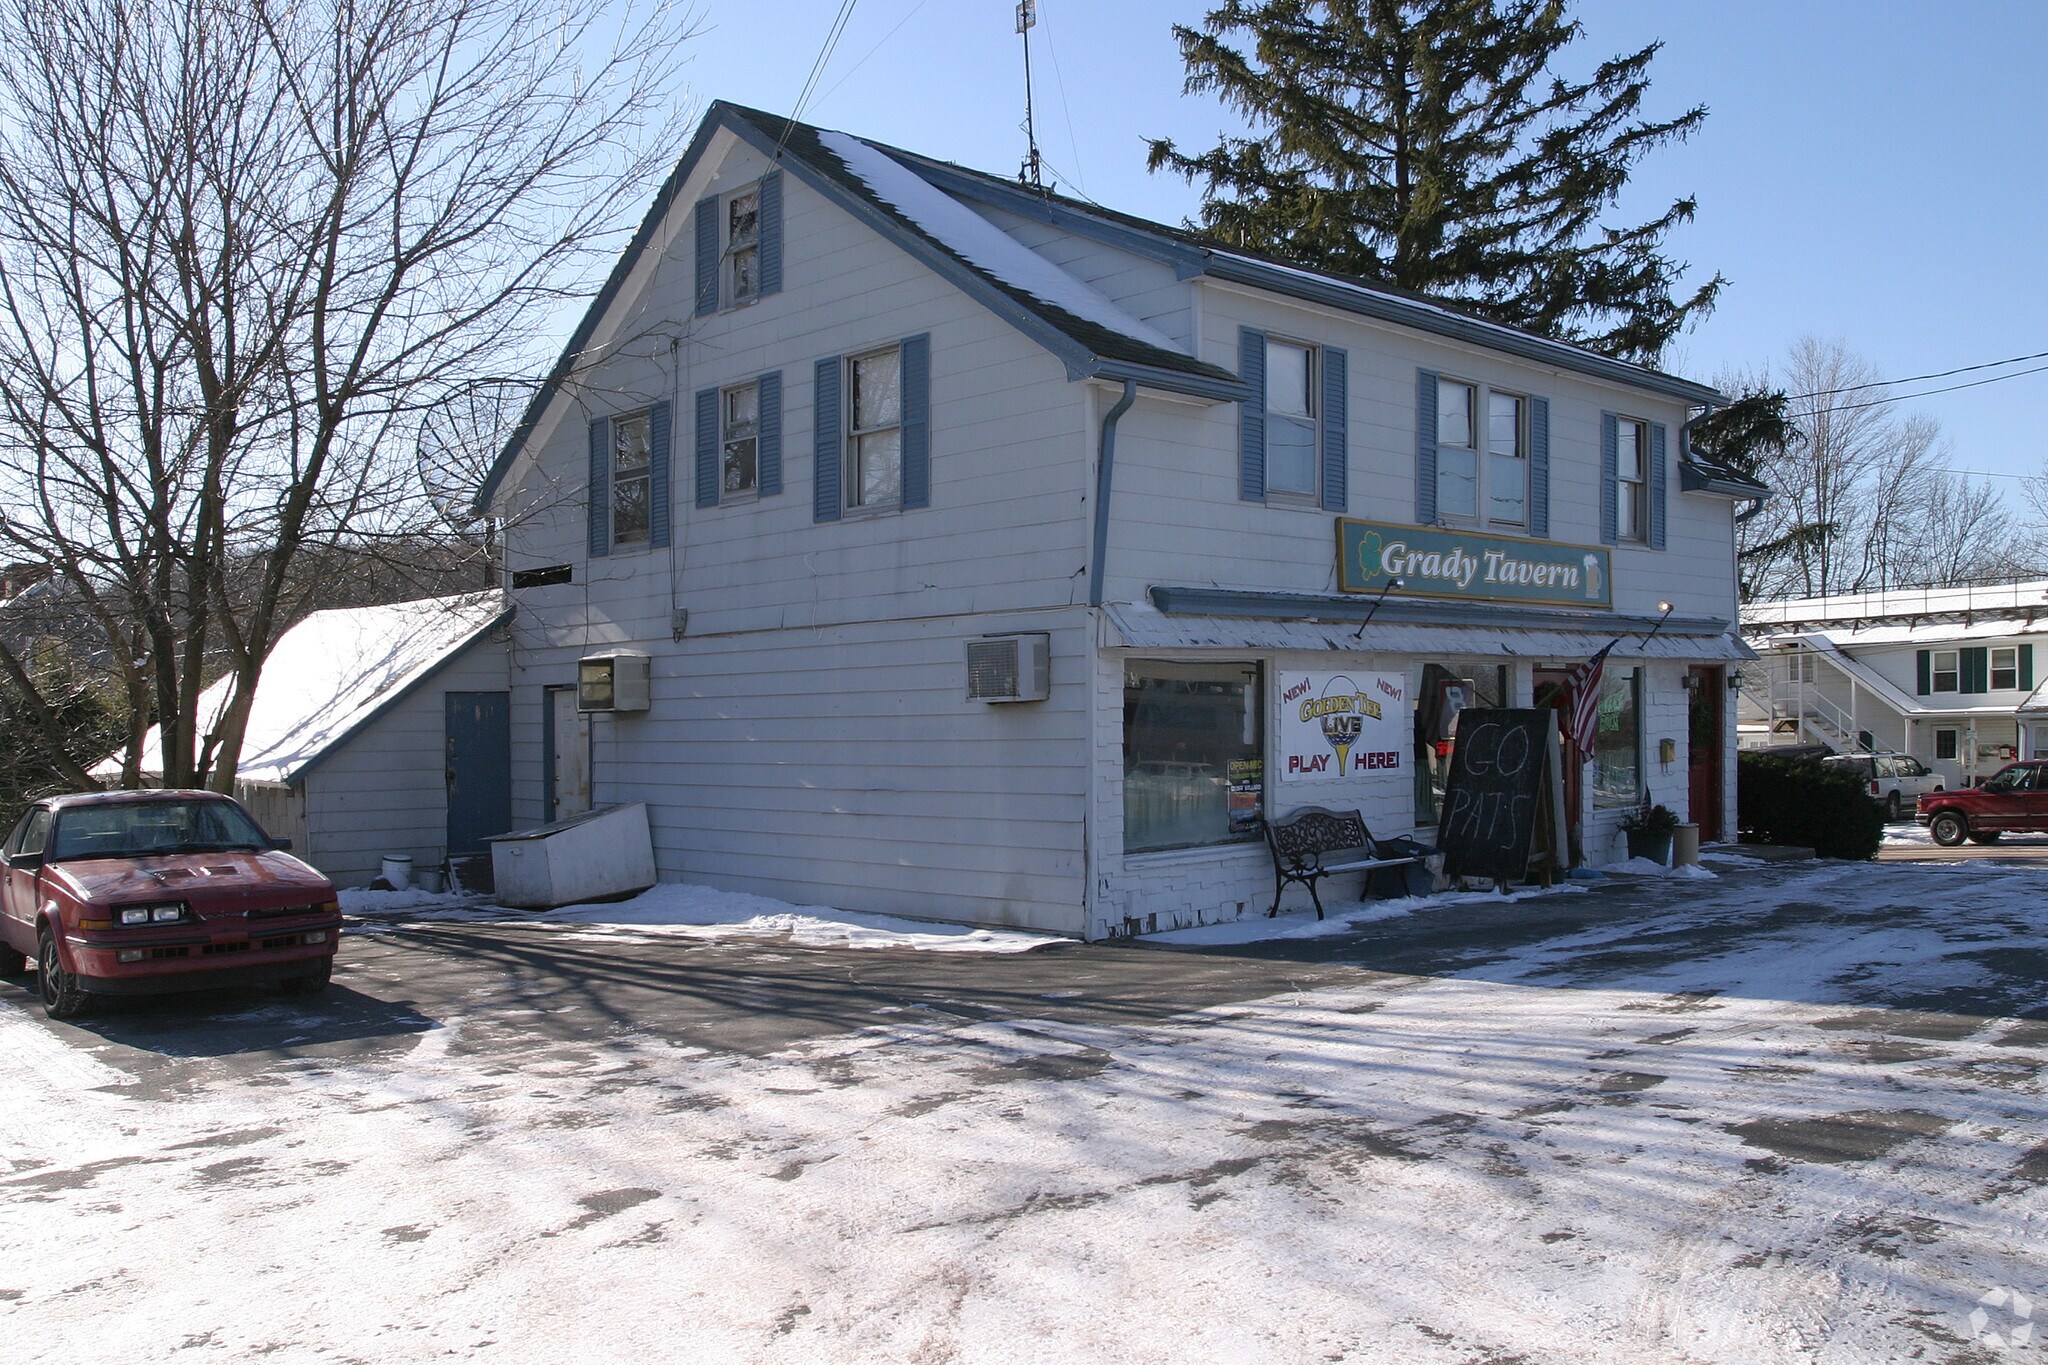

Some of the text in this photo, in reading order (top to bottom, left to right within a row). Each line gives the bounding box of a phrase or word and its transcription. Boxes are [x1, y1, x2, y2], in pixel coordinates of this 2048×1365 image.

[1381, 543, 1580, 588] Grady Tavern
[1283, 677, 1311, 704] NEW!
[1376, 678, 1402, 701] NEW!
[1299, 691, 1382, 722] GOLDEN TEE
[1323, 716, 1361, 734] LIVE
[1289, 752, 1399, 773] PLAY HERE!
[1464, 723, 1529, 776] GO
[1445, 788, 1530, 850] PATS
